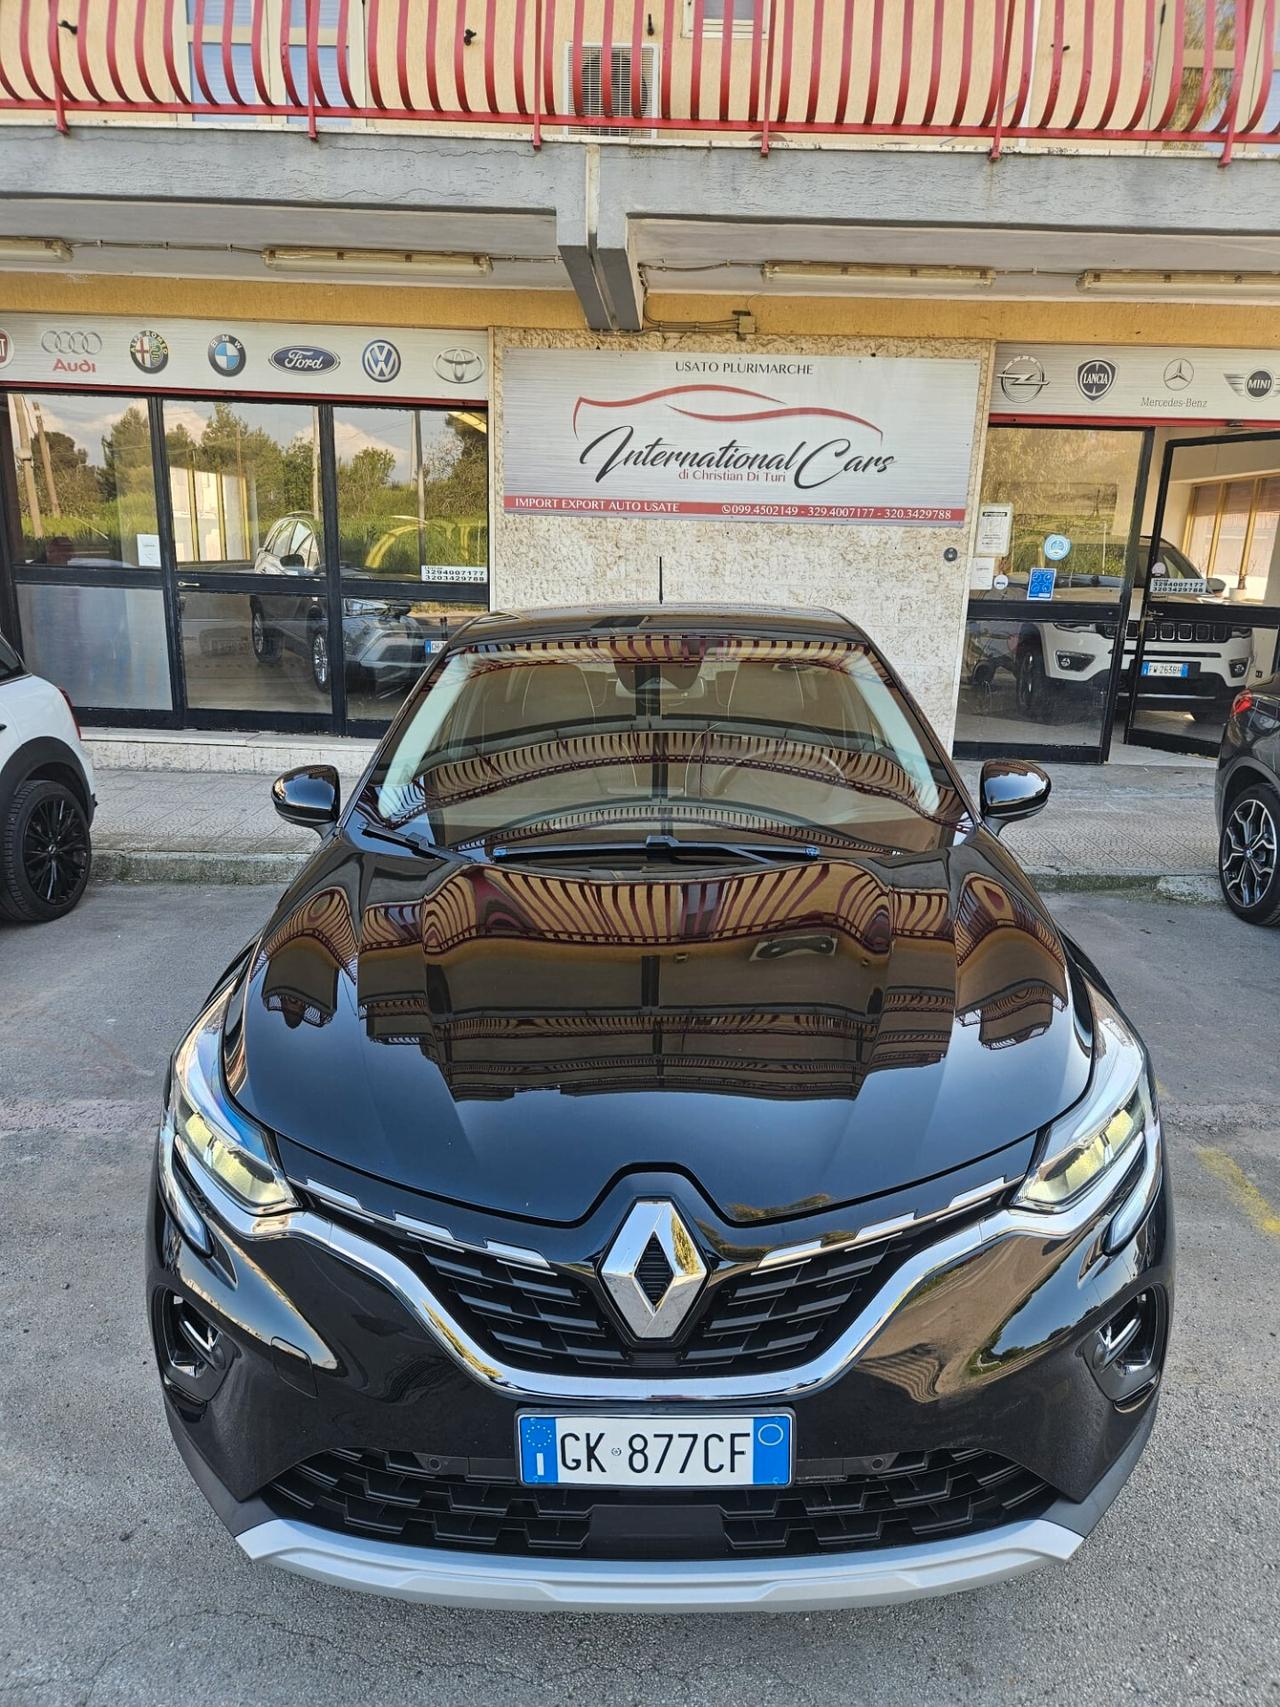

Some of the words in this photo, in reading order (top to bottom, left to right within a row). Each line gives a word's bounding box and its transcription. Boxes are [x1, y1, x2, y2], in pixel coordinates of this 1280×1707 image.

[210, 334, 243, 350] BMW
[53, 358, 97, 374] Audi
[284, 349, 324, 370] Ford
[674, 361, 719, 373] USATO
[722, 362, 815, 376] PLURIMARCHE
[1083, 372, 1109, 385] LANCIA
[1247, 379, 1271, 390] MINI
[1140, 396, 1208, 409] Mercedes-Benz
[579, 425, 807, 484] International
[793, 438, 897, 490] Cars
[678, 468, 690, 480] di
[691, 469, 744, 482] Christian
[746, 470, 761, 483] Di
[762, 471, 787, 483] Turi
[514, 497, 559, 509] IMPORT
[561, 499, 605, 511] EXPORT
[608, 501, 641, 512] AUTO
[643, 501, 681, 513] USATE
[731, 504, 799, 516] 099.4502149
[807, 506, 874, 518] 329.4007177
[884, 507, 952, 520] 320.3429788
[560, 1432, 607, 1473] GK
[628, 1433, 751, 1474] 877CF
